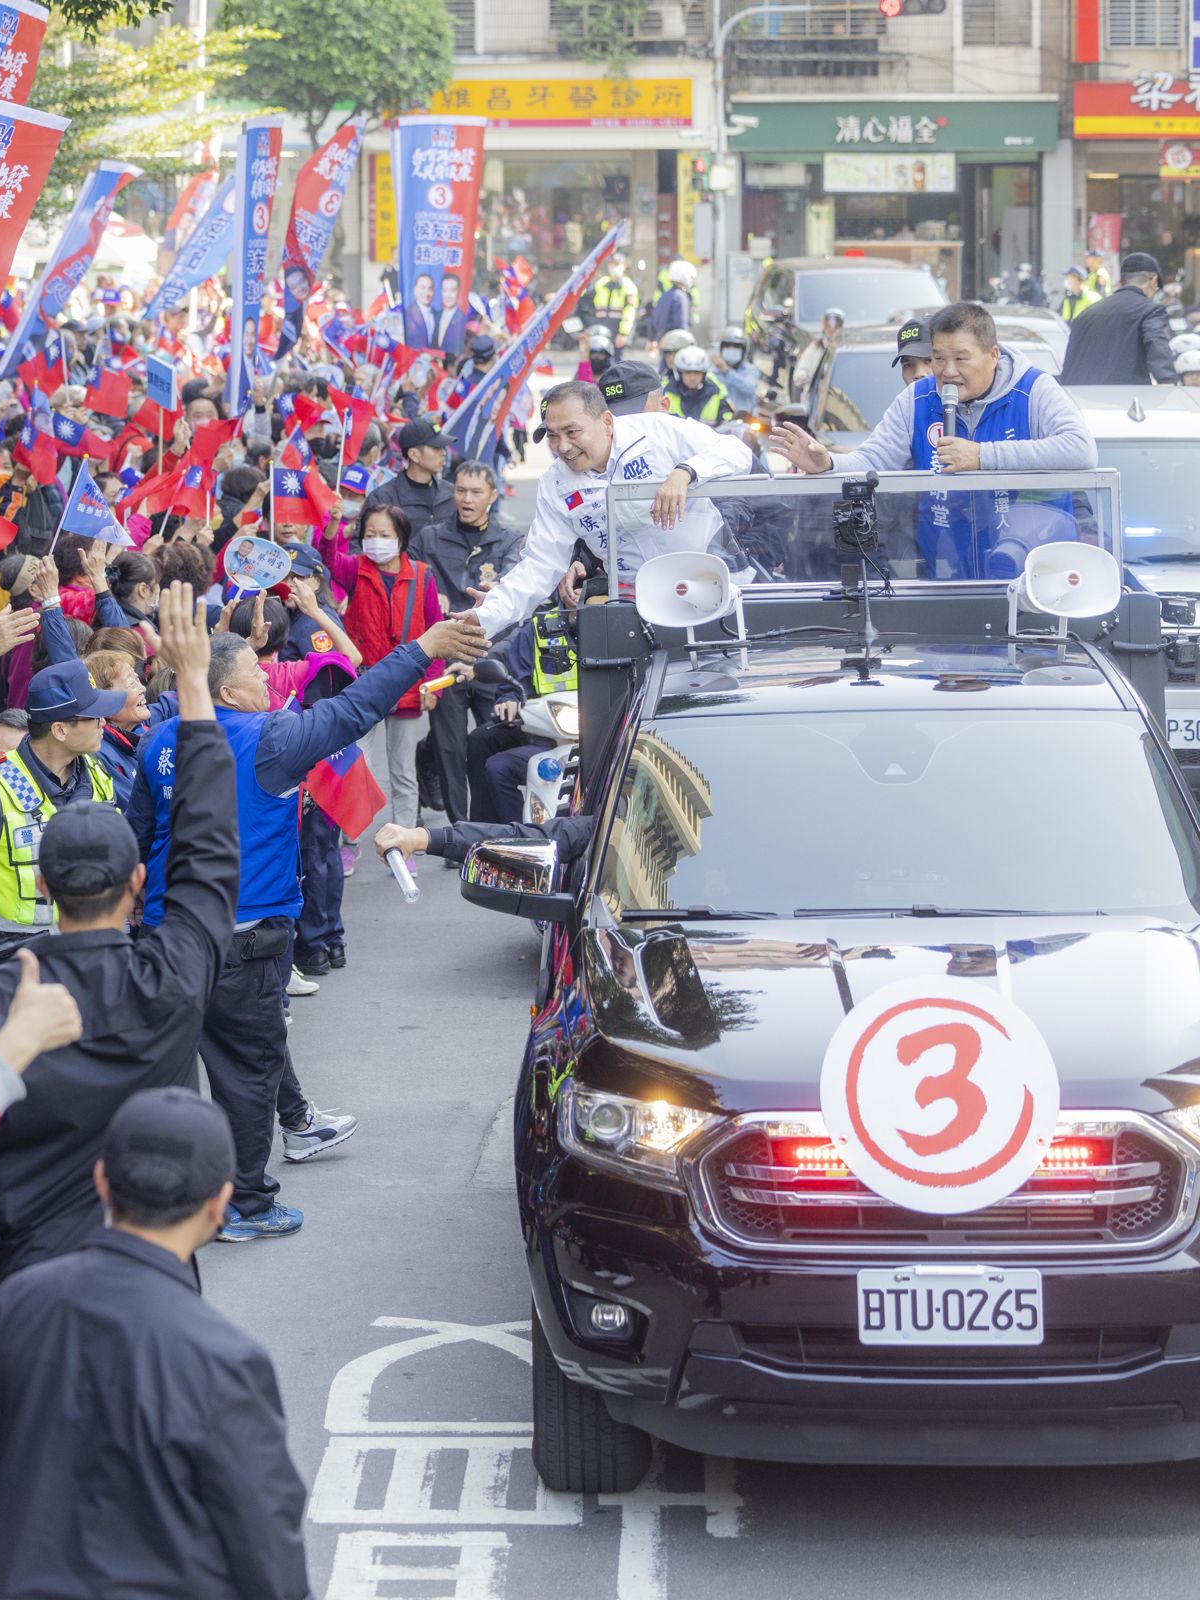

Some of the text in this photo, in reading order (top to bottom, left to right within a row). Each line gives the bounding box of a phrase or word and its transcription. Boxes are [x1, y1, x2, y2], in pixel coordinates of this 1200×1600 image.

[835, 115, 938, 144] 清心福全
[433, 186, 447, 206] 3
[256, 205, 265, 230] 3
[414, 220, 464, 243] 侯友宜
[414, 243, 463, 267] 趙少康
[901, 328, 919, 340] SSC
[605, 384, 623, 397] SSC
[623, 456, 650, 481] 2024
[158, 747, 175, 777] 蔡
[895, 1022, 988, 1157] 3
